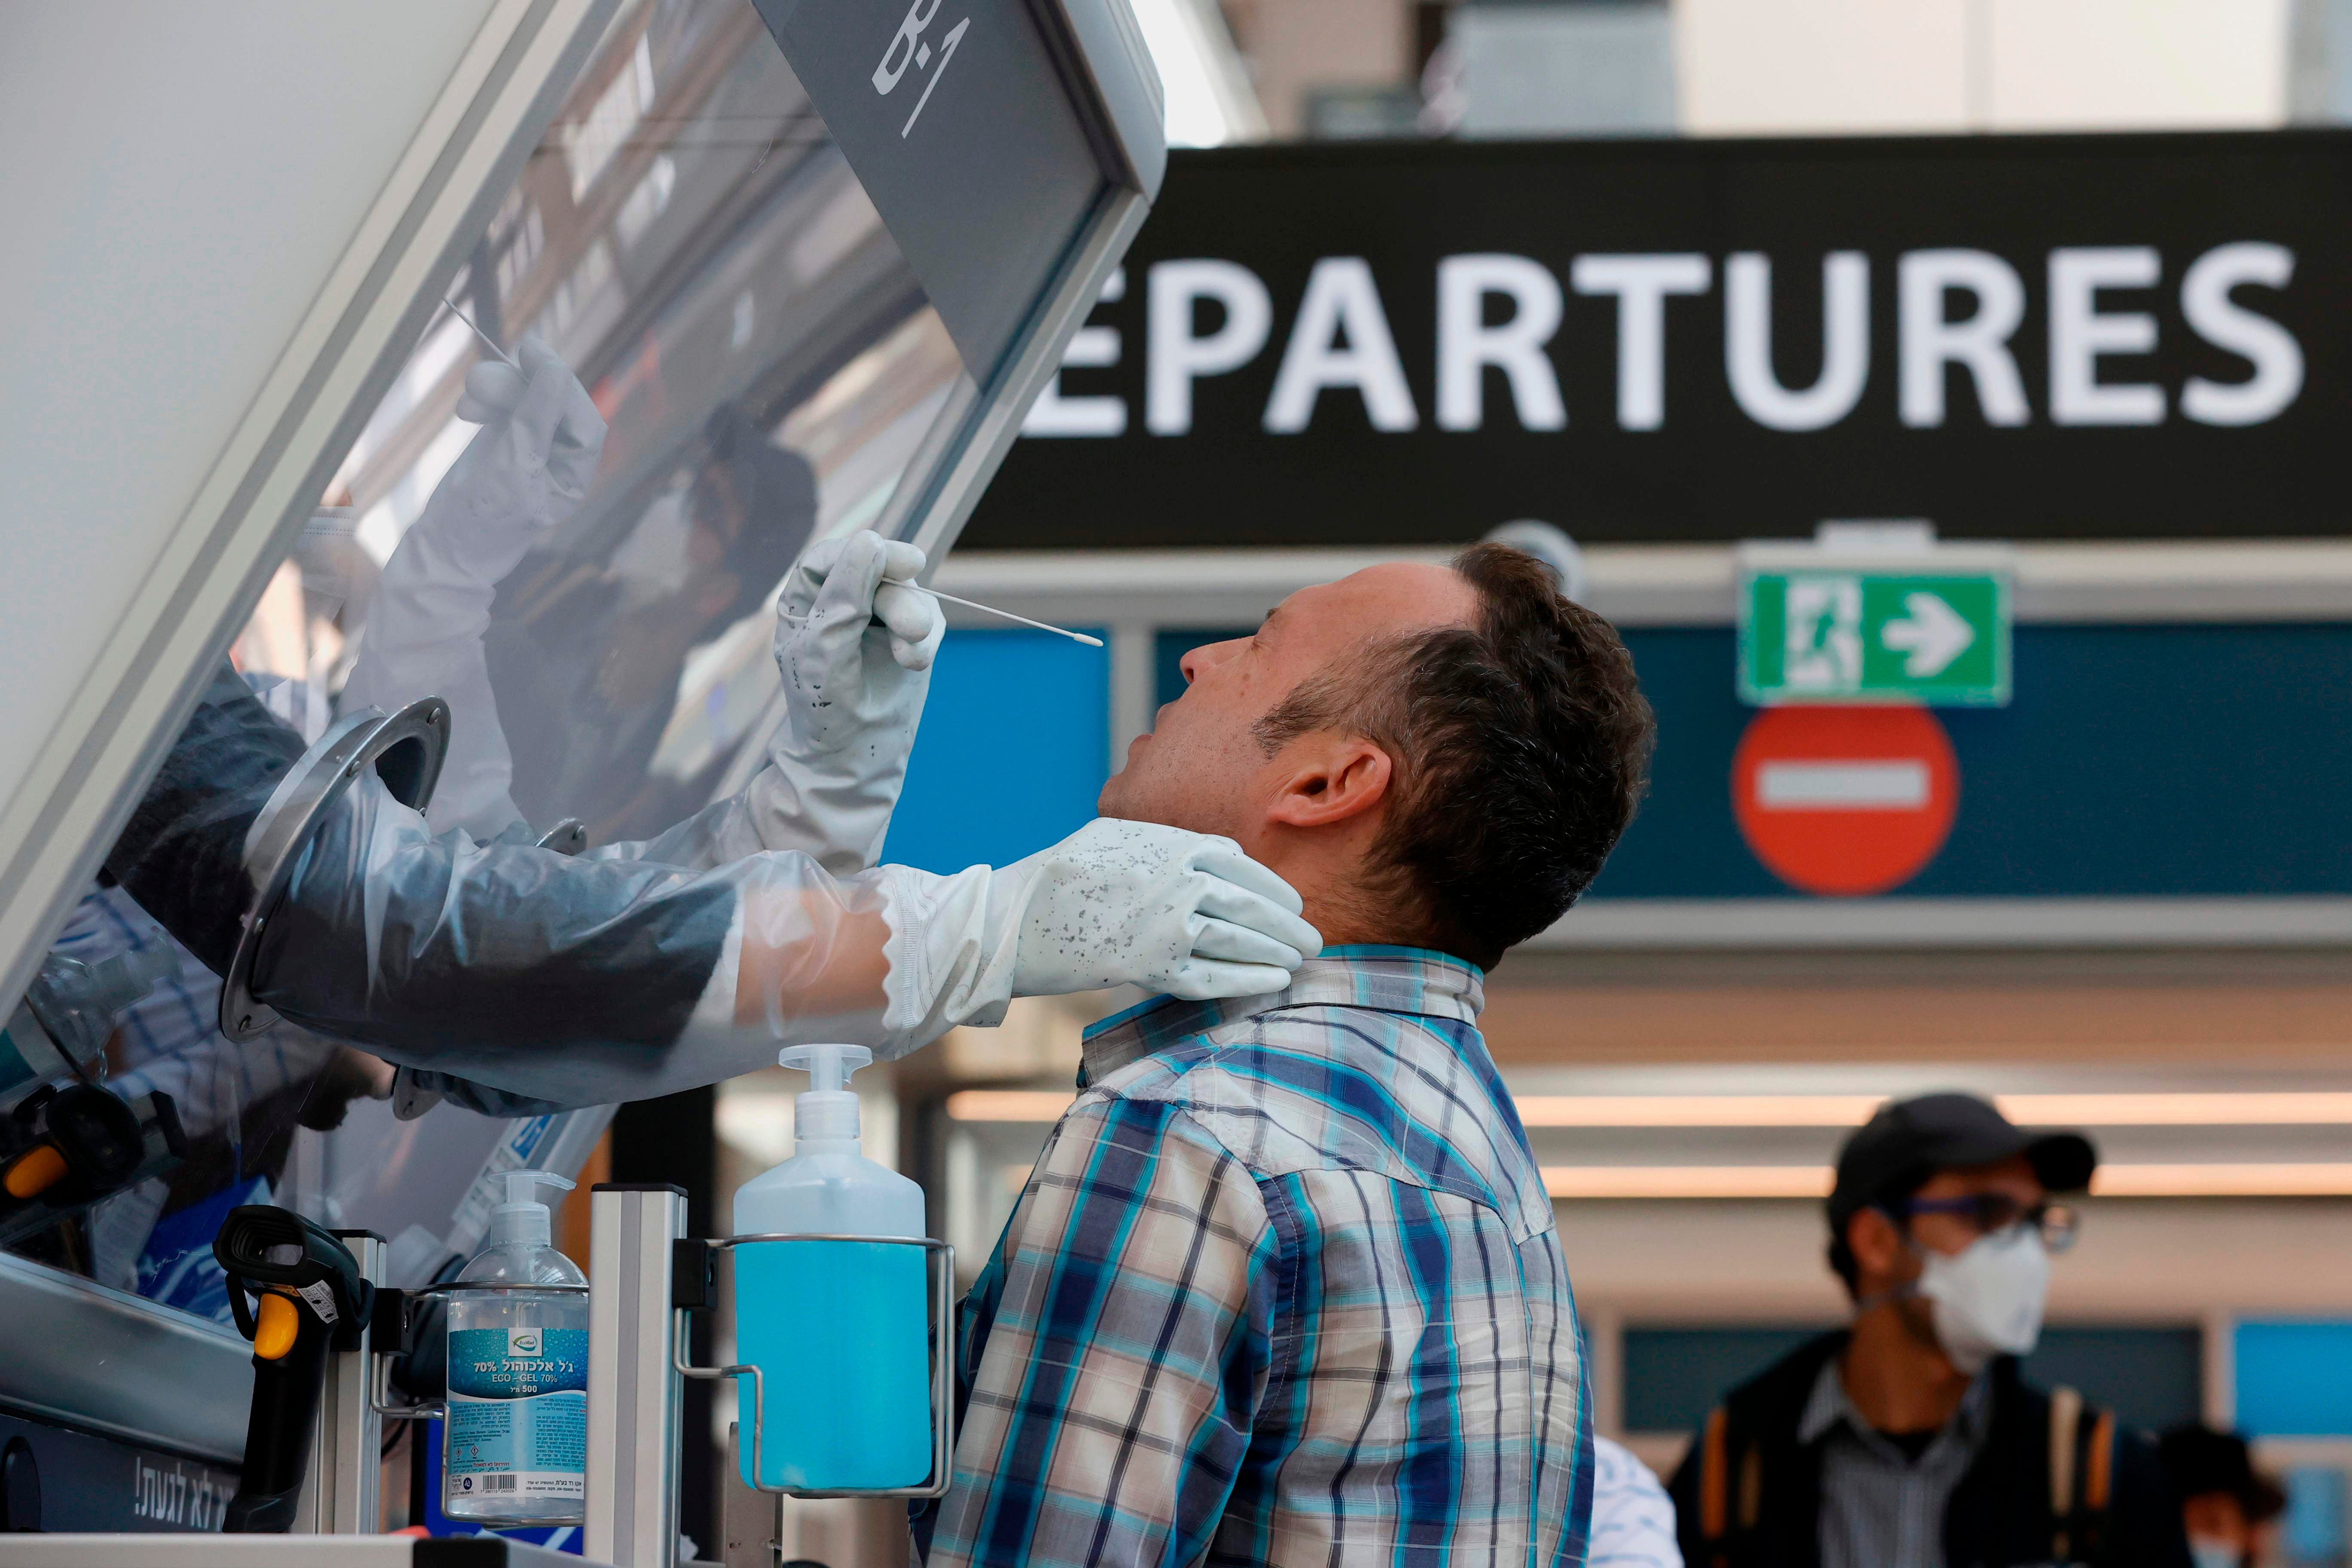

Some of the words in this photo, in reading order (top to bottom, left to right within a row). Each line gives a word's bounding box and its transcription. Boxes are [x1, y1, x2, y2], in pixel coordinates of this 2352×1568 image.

[474, 1361, 497, 1373] 70%
[502, 1359, 554, 1372] אלכוהול
[559, 1360, 573, 1373] ג'ל
[492, 1374, 511, 1382] ECO
[520, 1374, 539, 1382] GEL
[541, 1374, 558, 1383] 70%
[135, 1457, 187, 1524] לגעת!
[191, 1469, 213, 1530] לא
